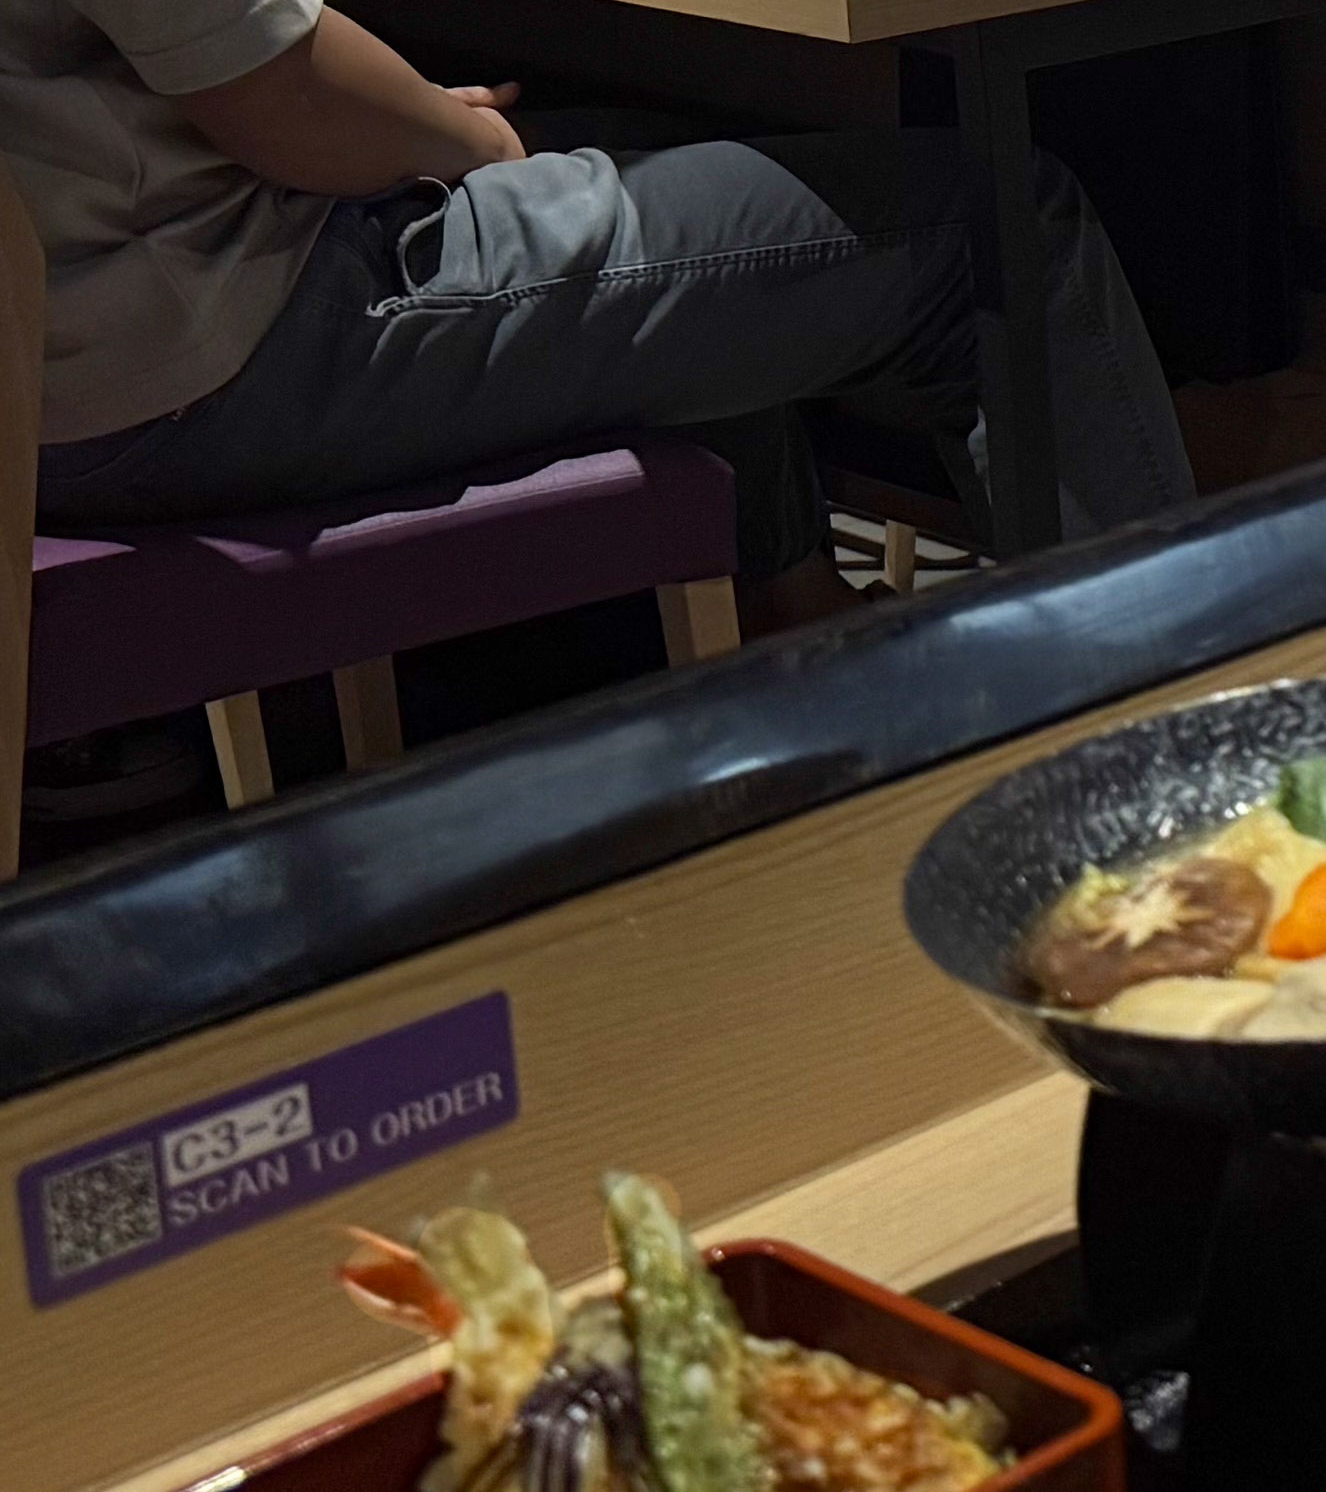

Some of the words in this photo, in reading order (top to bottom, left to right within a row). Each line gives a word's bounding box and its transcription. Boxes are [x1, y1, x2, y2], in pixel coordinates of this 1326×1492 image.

[168, 1156, 290, 1228] SCAN
[305, 1128, 359, 1173] TO
[371, 1071, 503, 1147] ORDER
[172, 1094, 304, 1174] C3-2
